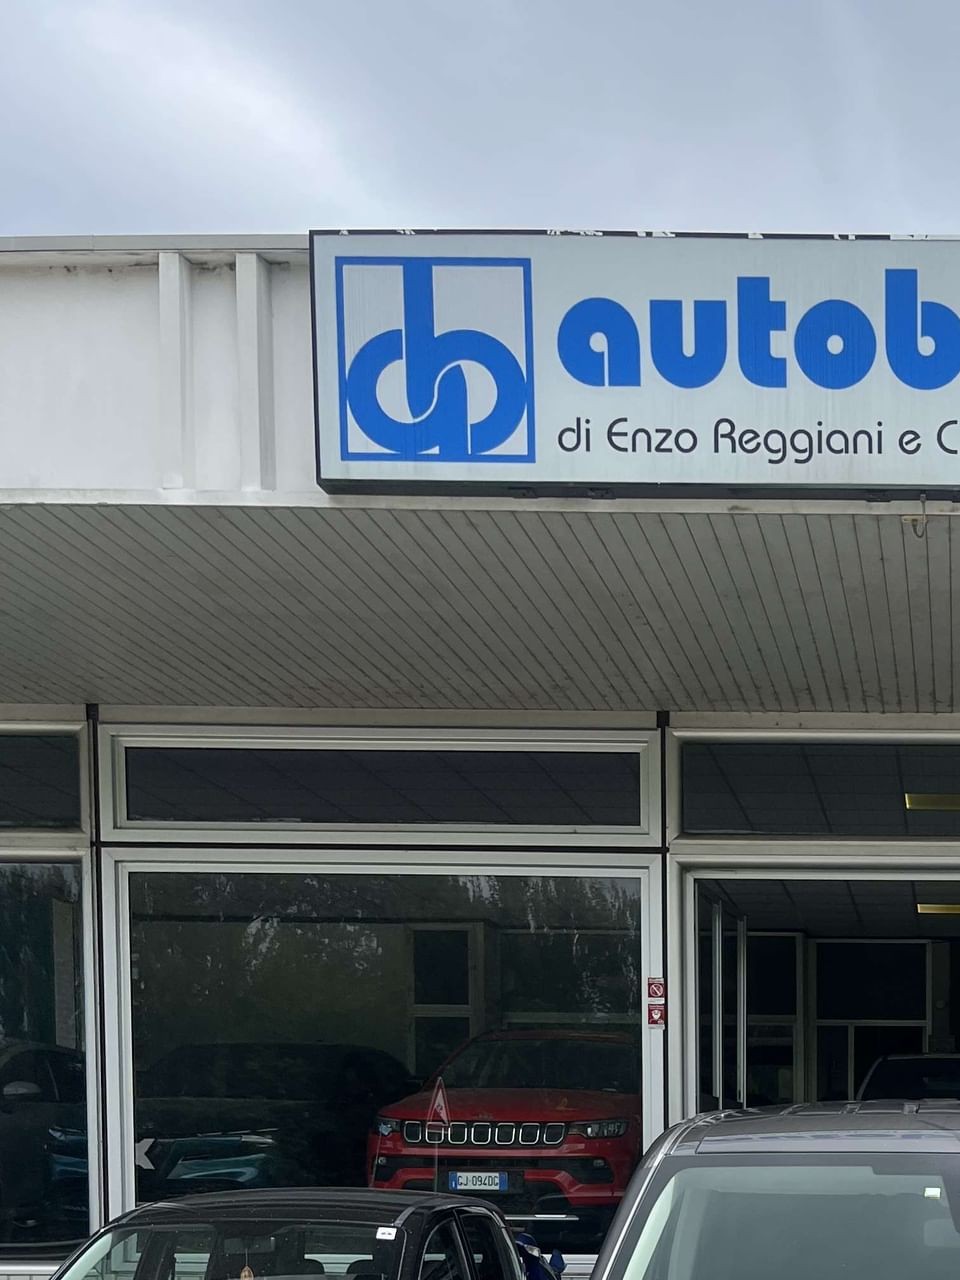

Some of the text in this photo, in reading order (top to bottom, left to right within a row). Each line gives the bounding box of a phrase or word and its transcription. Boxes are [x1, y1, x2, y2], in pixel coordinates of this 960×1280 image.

[557, 416, 591, 453] di
[606, 416, 698, 454] Enzo
[713, 417, 883, 465] Reggiani
[898, 429, 922, 455] e
